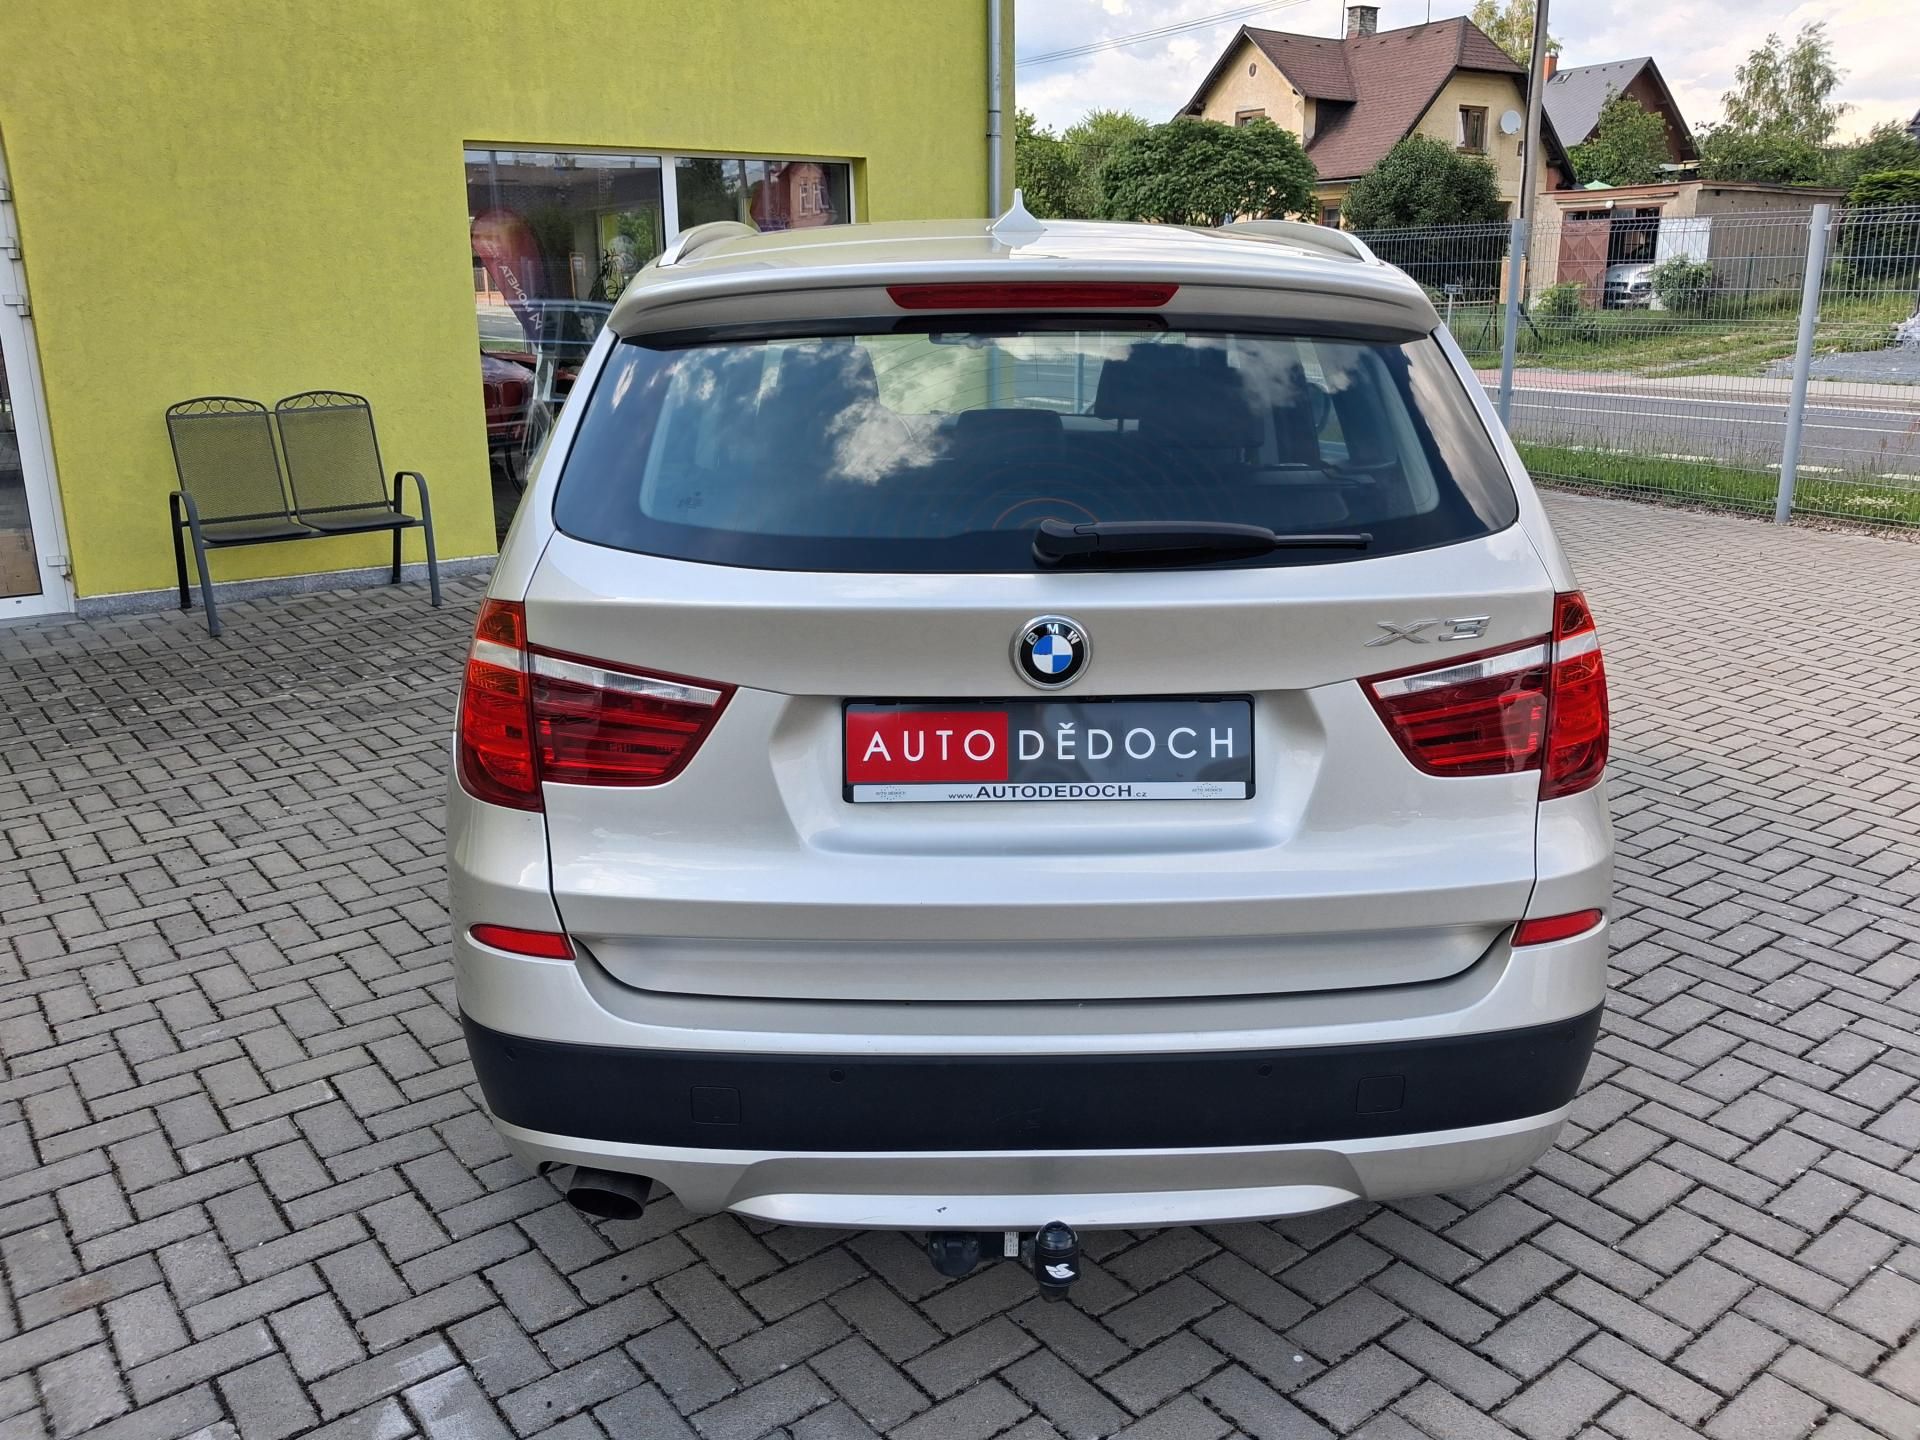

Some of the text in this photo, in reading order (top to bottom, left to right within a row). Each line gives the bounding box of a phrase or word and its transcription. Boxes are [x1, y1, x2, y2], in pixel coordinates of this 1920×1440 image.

[1025, 623, 1080, 646] BMW
[1364, 614, 1491, 647] X3
[863, 722, 1233, 762] AUTO DĚDOCH
